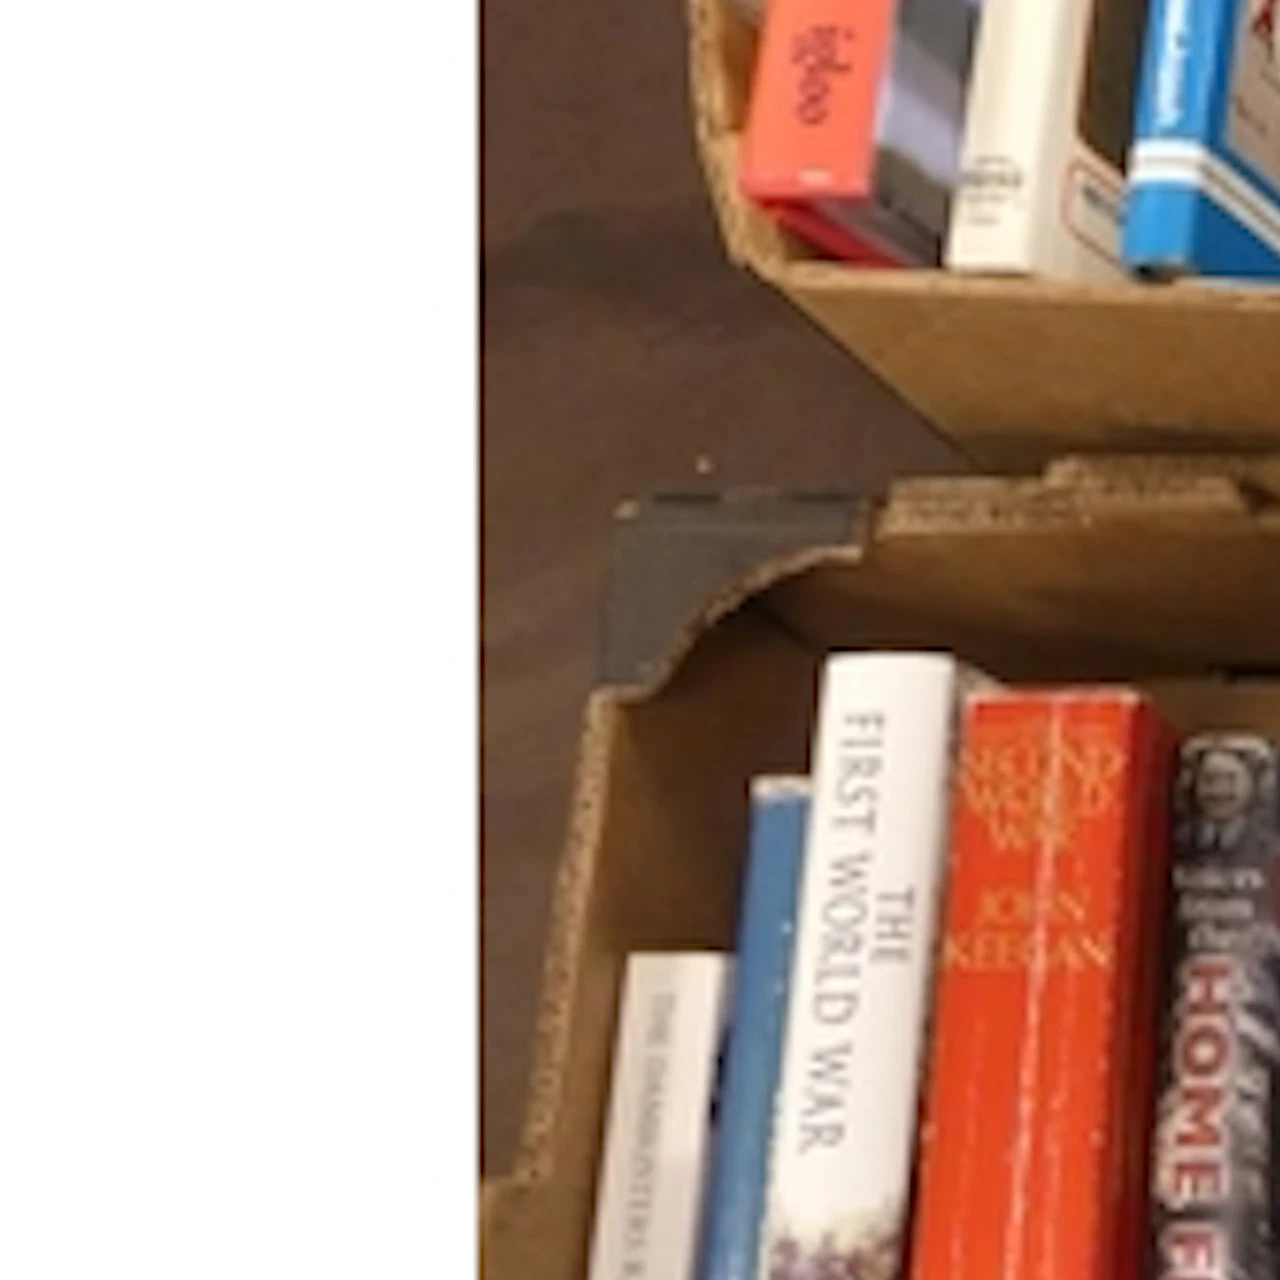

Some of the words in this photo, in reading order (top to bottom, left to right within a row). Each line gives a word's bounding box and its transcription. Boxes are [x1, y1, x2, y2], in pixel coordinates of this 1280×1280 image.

[779, 23, 859, 128] igloo
[828, 710, 887, 836] FIRST
[810, 851, 873, 1027] WORLD
[867, 888, 916, 964] THE
[797, 1044, 854, 1157] WAR
[1162, 959, 1239, 1204] HOME
